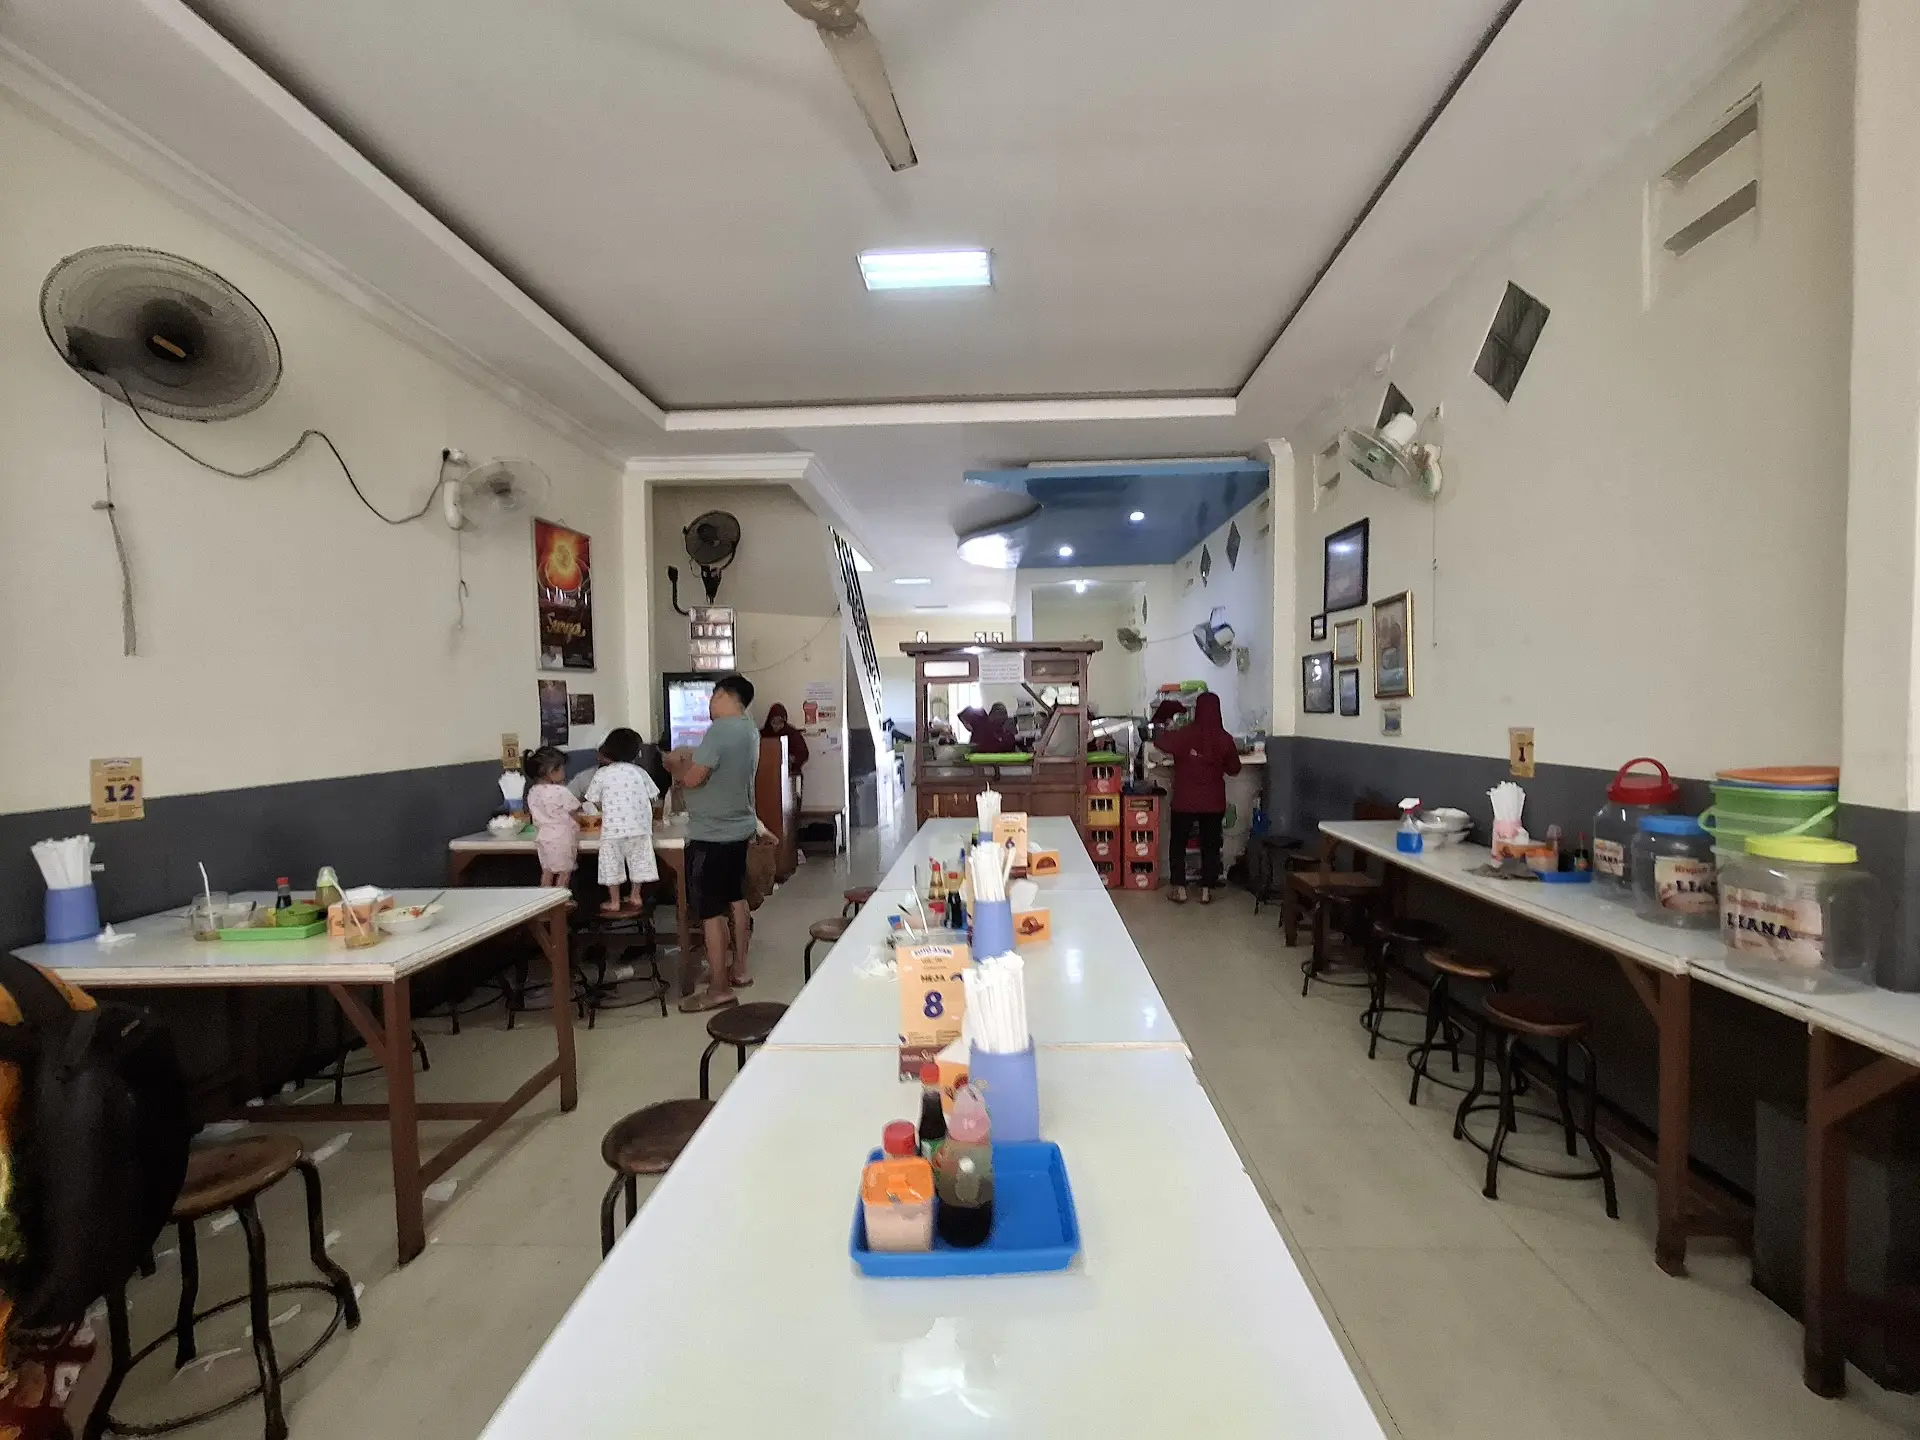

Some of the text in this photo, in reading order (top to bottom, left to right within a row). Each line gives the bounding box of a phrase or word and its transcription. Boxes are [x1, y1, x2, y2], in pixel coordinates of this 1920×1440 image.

[104, 784, 135, 803] 12
[1726, 911, 1796, 942] LIANA
[922, 990, 944, 1018] 8
